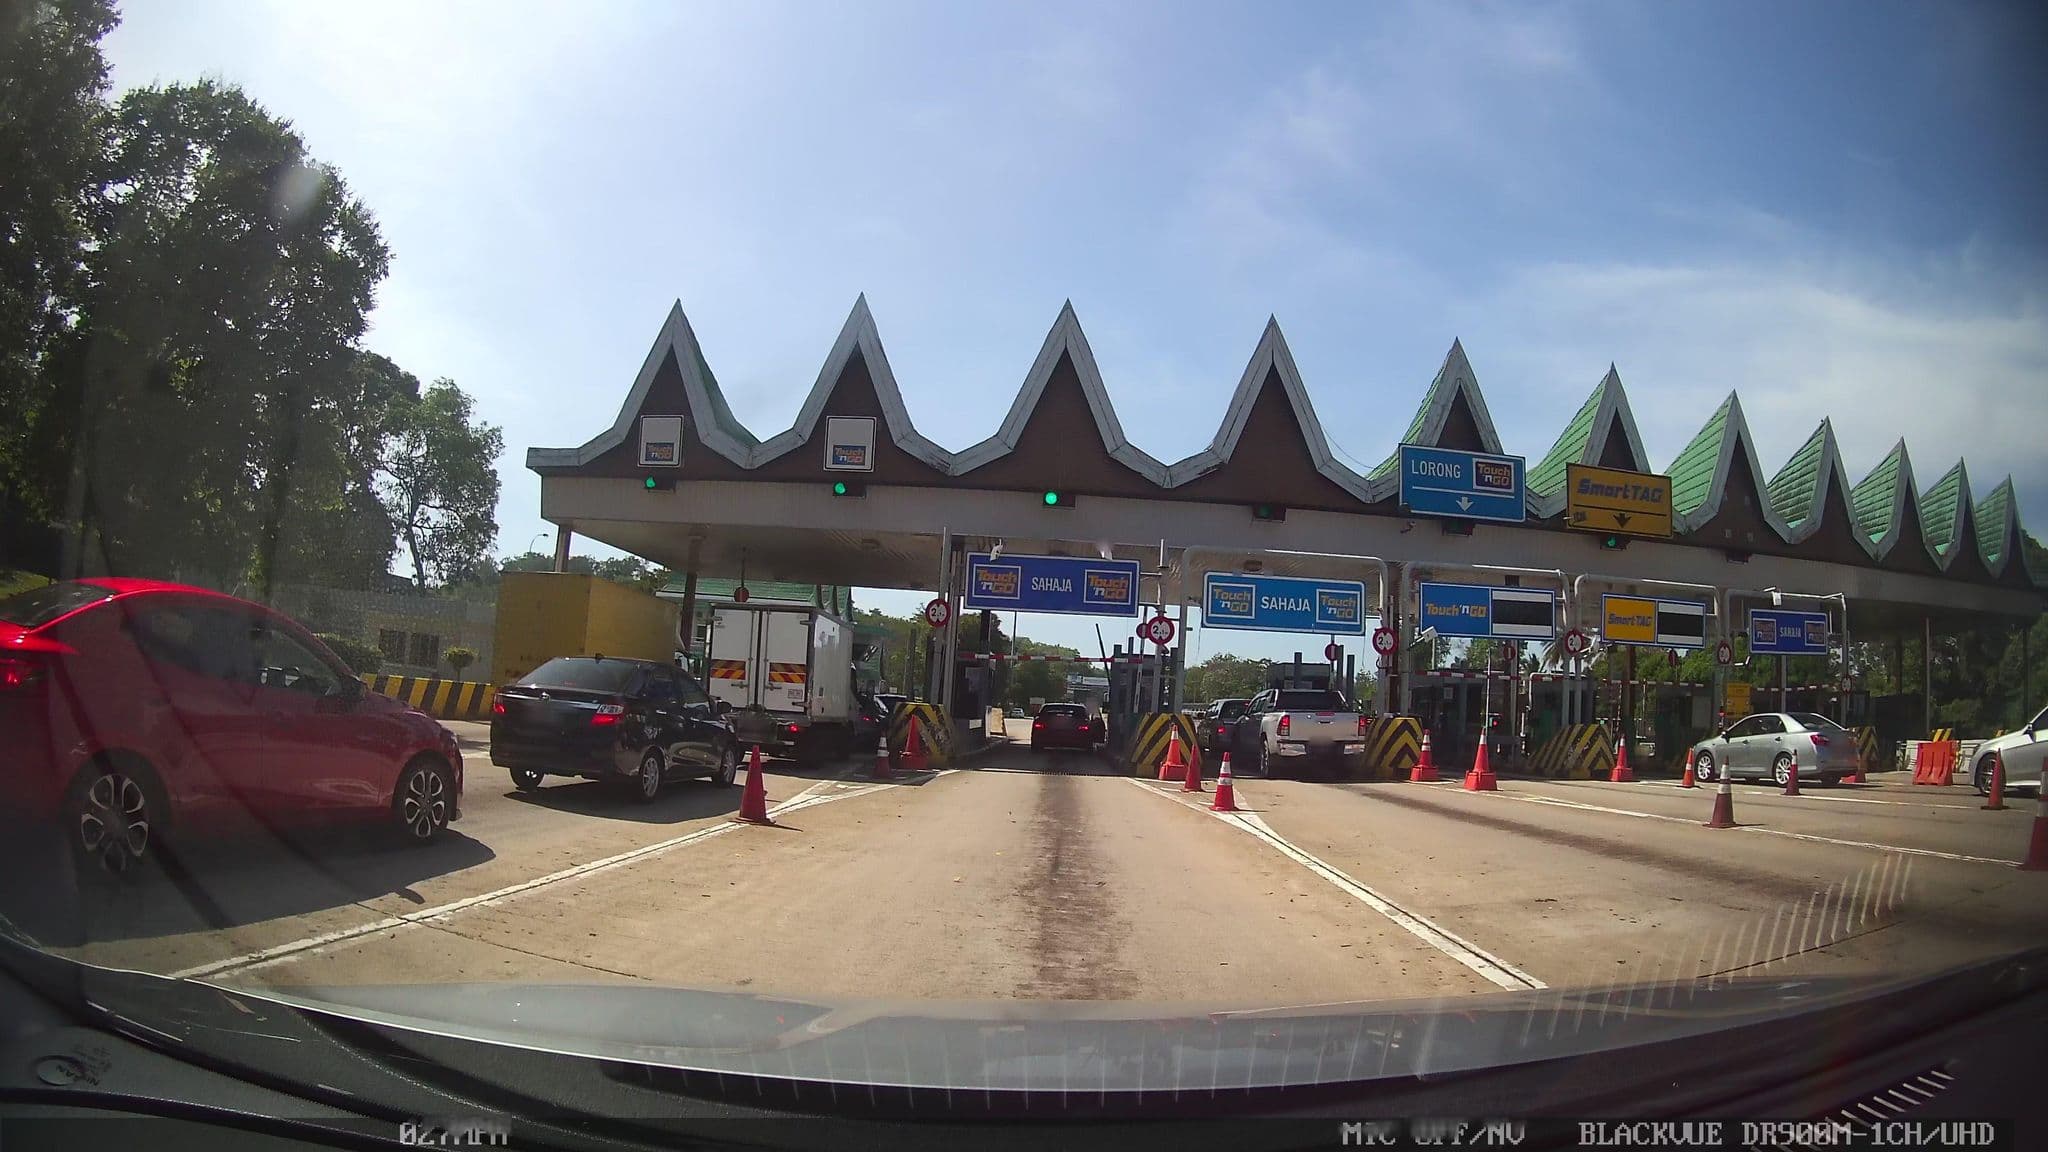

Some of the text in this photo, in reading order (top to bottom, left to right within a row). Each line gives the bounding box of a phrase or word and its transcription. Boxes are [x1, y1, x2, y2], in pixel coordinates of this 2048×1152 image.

[1411, 459, 1461, 479] LORONG
[1478, 463, 1511, 477] Touch
[977, 569, 1017, 583] Touch
[1088, 575, 1129, 588] Touch
[1031, 576, 1072, 593] SAHAJA
[1213, 588, 1251, 601] Touch
[1320, 594, 1356, 607] Touch
[1261, 596, 1311, 612] SAHAJA
